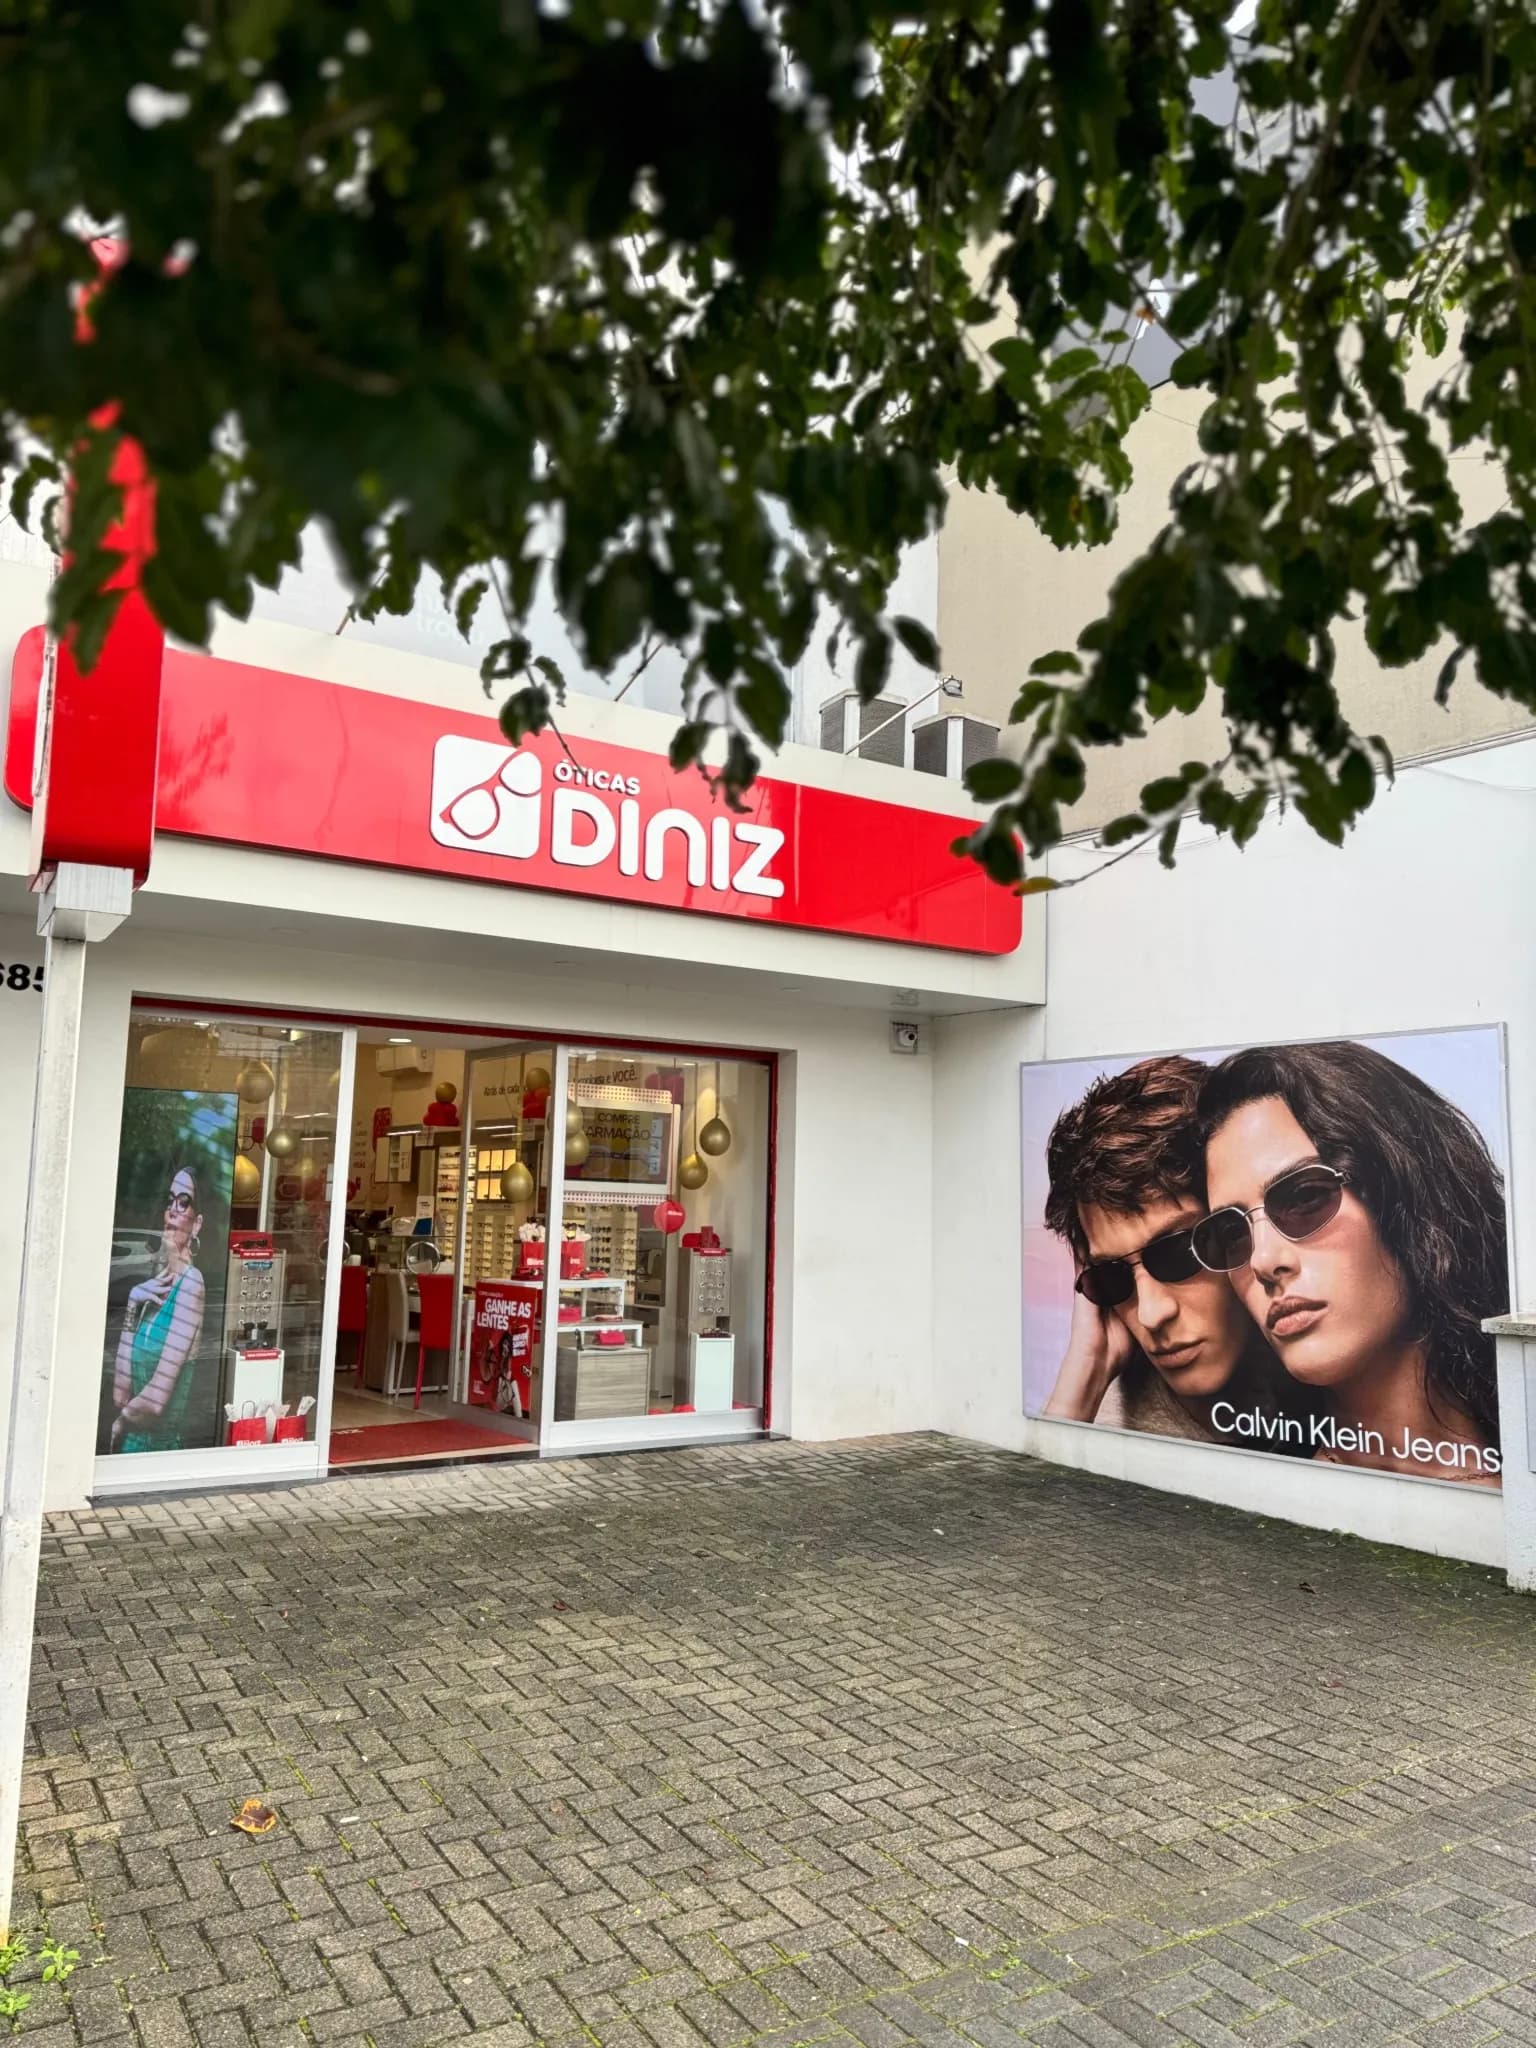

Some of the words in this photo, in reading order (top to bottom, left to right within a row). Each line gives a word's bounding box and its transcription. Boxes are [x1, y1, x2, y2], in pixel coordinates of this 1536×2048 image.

[552, 758, 641, 796] ÓTICAS
[585, 1125, 652, 1142] ARMAÇÃO
[485, 1298, 517, 1317] GANHE
[518, 1301, 532, 1319] AS
[476, 1311, 509, 1331] LENTES
[1210, 1401, 1303, 1444] Calvin
[1310, 1414, 1385, 1456] Klein
[1391, 1426, 1502, 1474] Jeans
